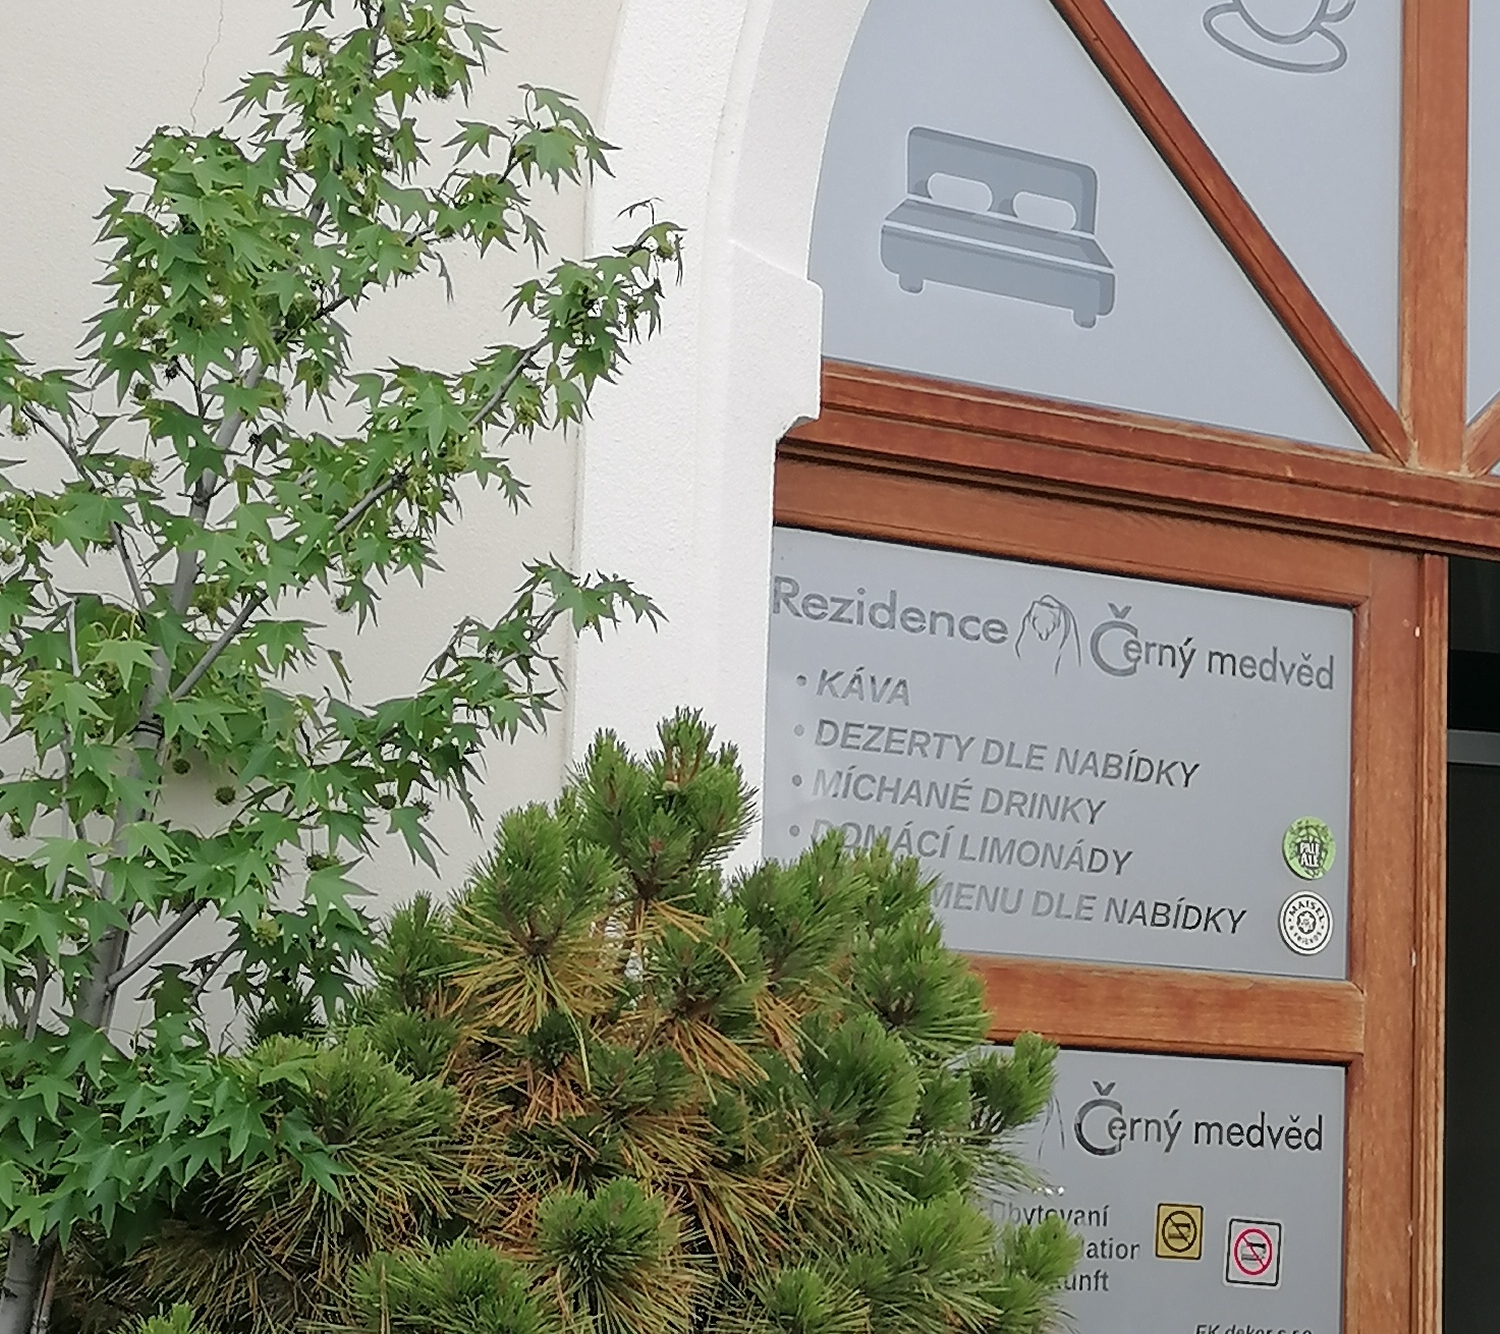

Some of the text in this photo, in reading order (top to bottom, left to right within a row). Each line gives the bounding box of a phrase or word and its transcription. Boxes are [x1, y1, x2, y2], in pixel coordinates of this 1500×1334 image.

[771, 575, 1335, 691] Rezidence Černý medvěd
[816, 667, 910, 707] KÁVA
[814, 718, 1201, 789] DEZERTY DLE NABÍDKY
[811, 765, 1107, 825] MÍCHANÉ DRINKY
[957, 832, 1134, 876] LIMONÁDY
[1030, 889, 1097, 922] DLE
[1103, 897, 1247, 935] NABÍDKY
[1074, 1080, 1324, 1156] Černý medvěd
